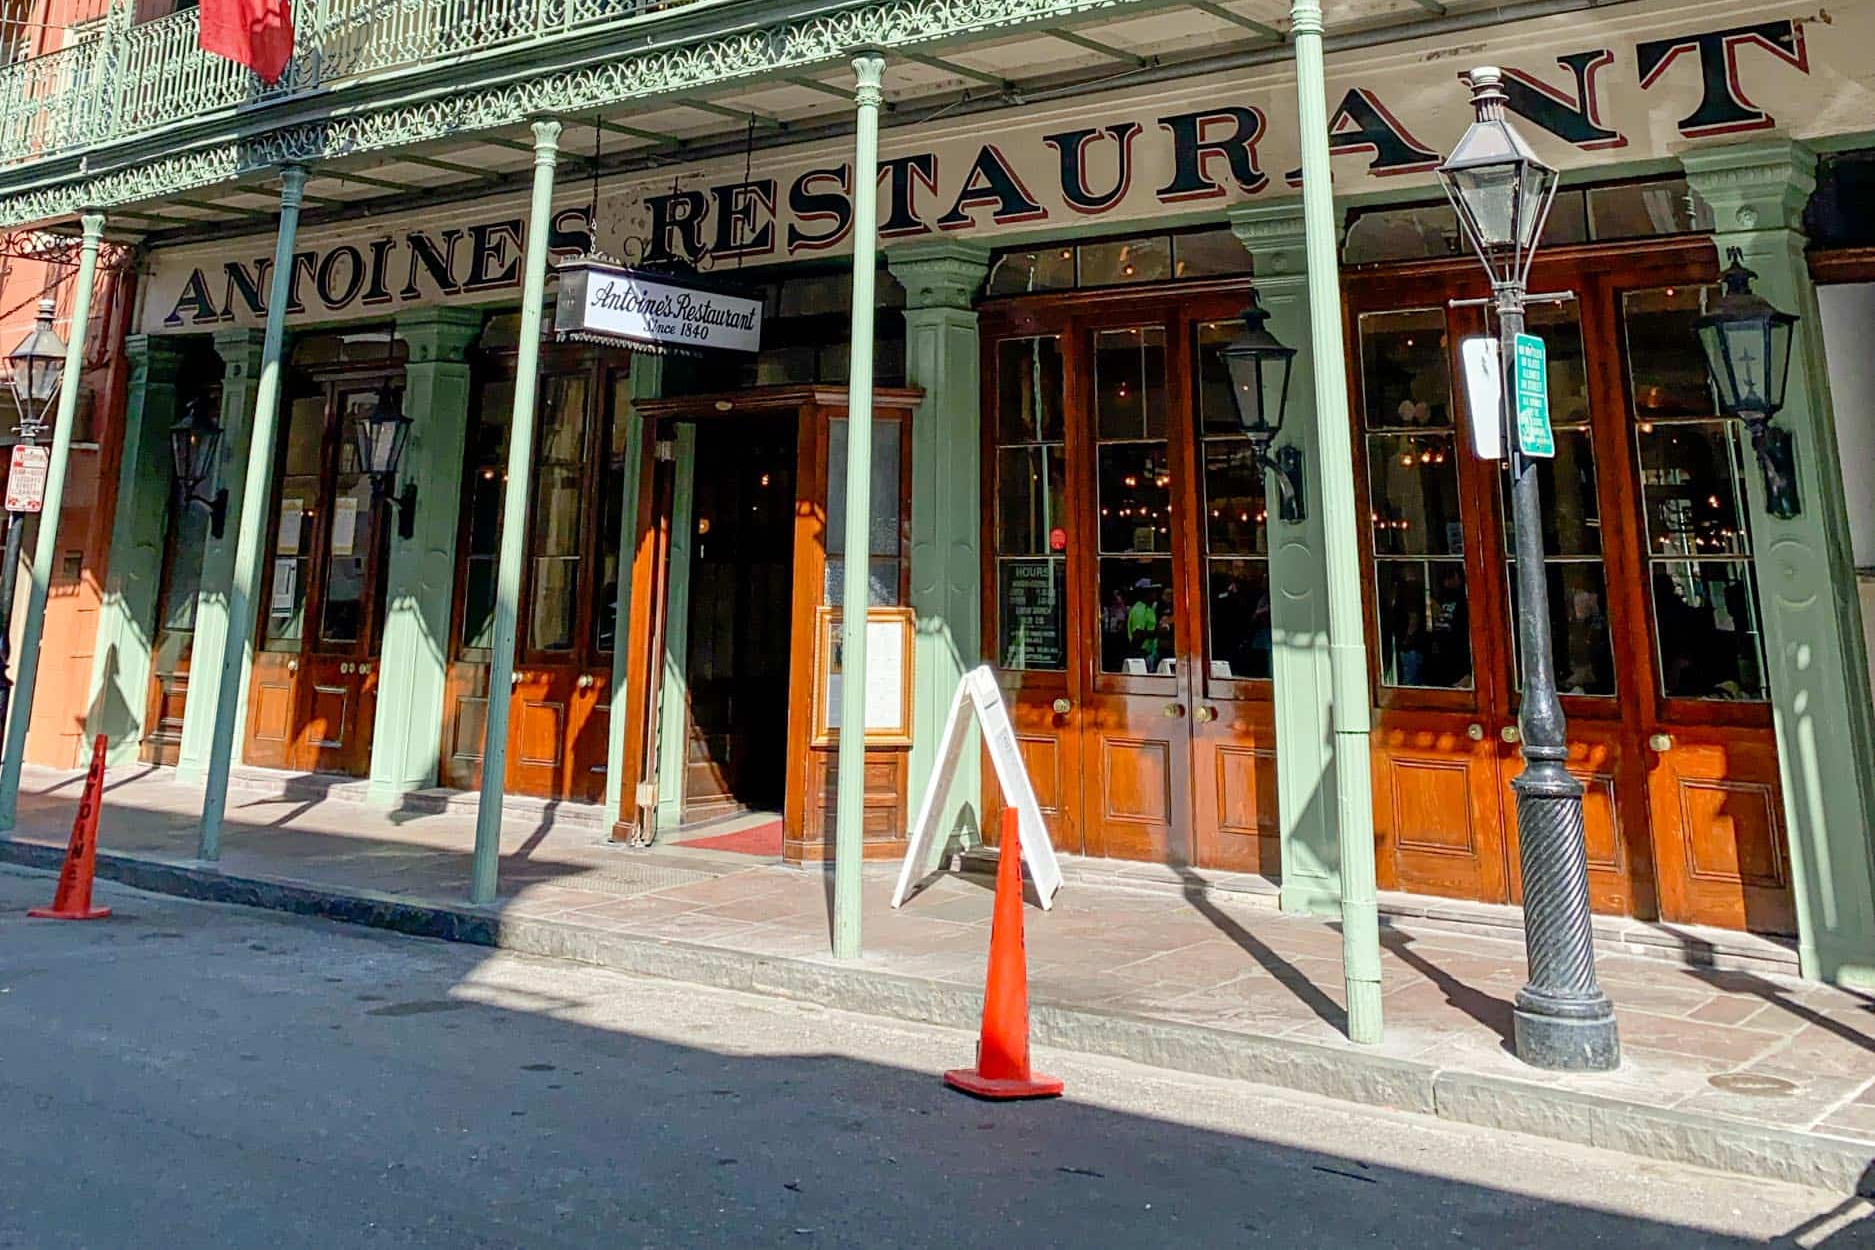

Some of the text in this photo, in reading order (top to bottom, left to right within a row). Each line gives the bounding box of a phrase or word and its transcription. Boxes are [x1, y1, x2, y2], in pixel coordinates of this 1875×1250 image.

[642, 19, 1811, 267] RESTAURANT
[591, 281, 673, 317] Antoine's
[671, 293, 756, 331] Restaurant
[643, 317, 710, 341] Since 1840
